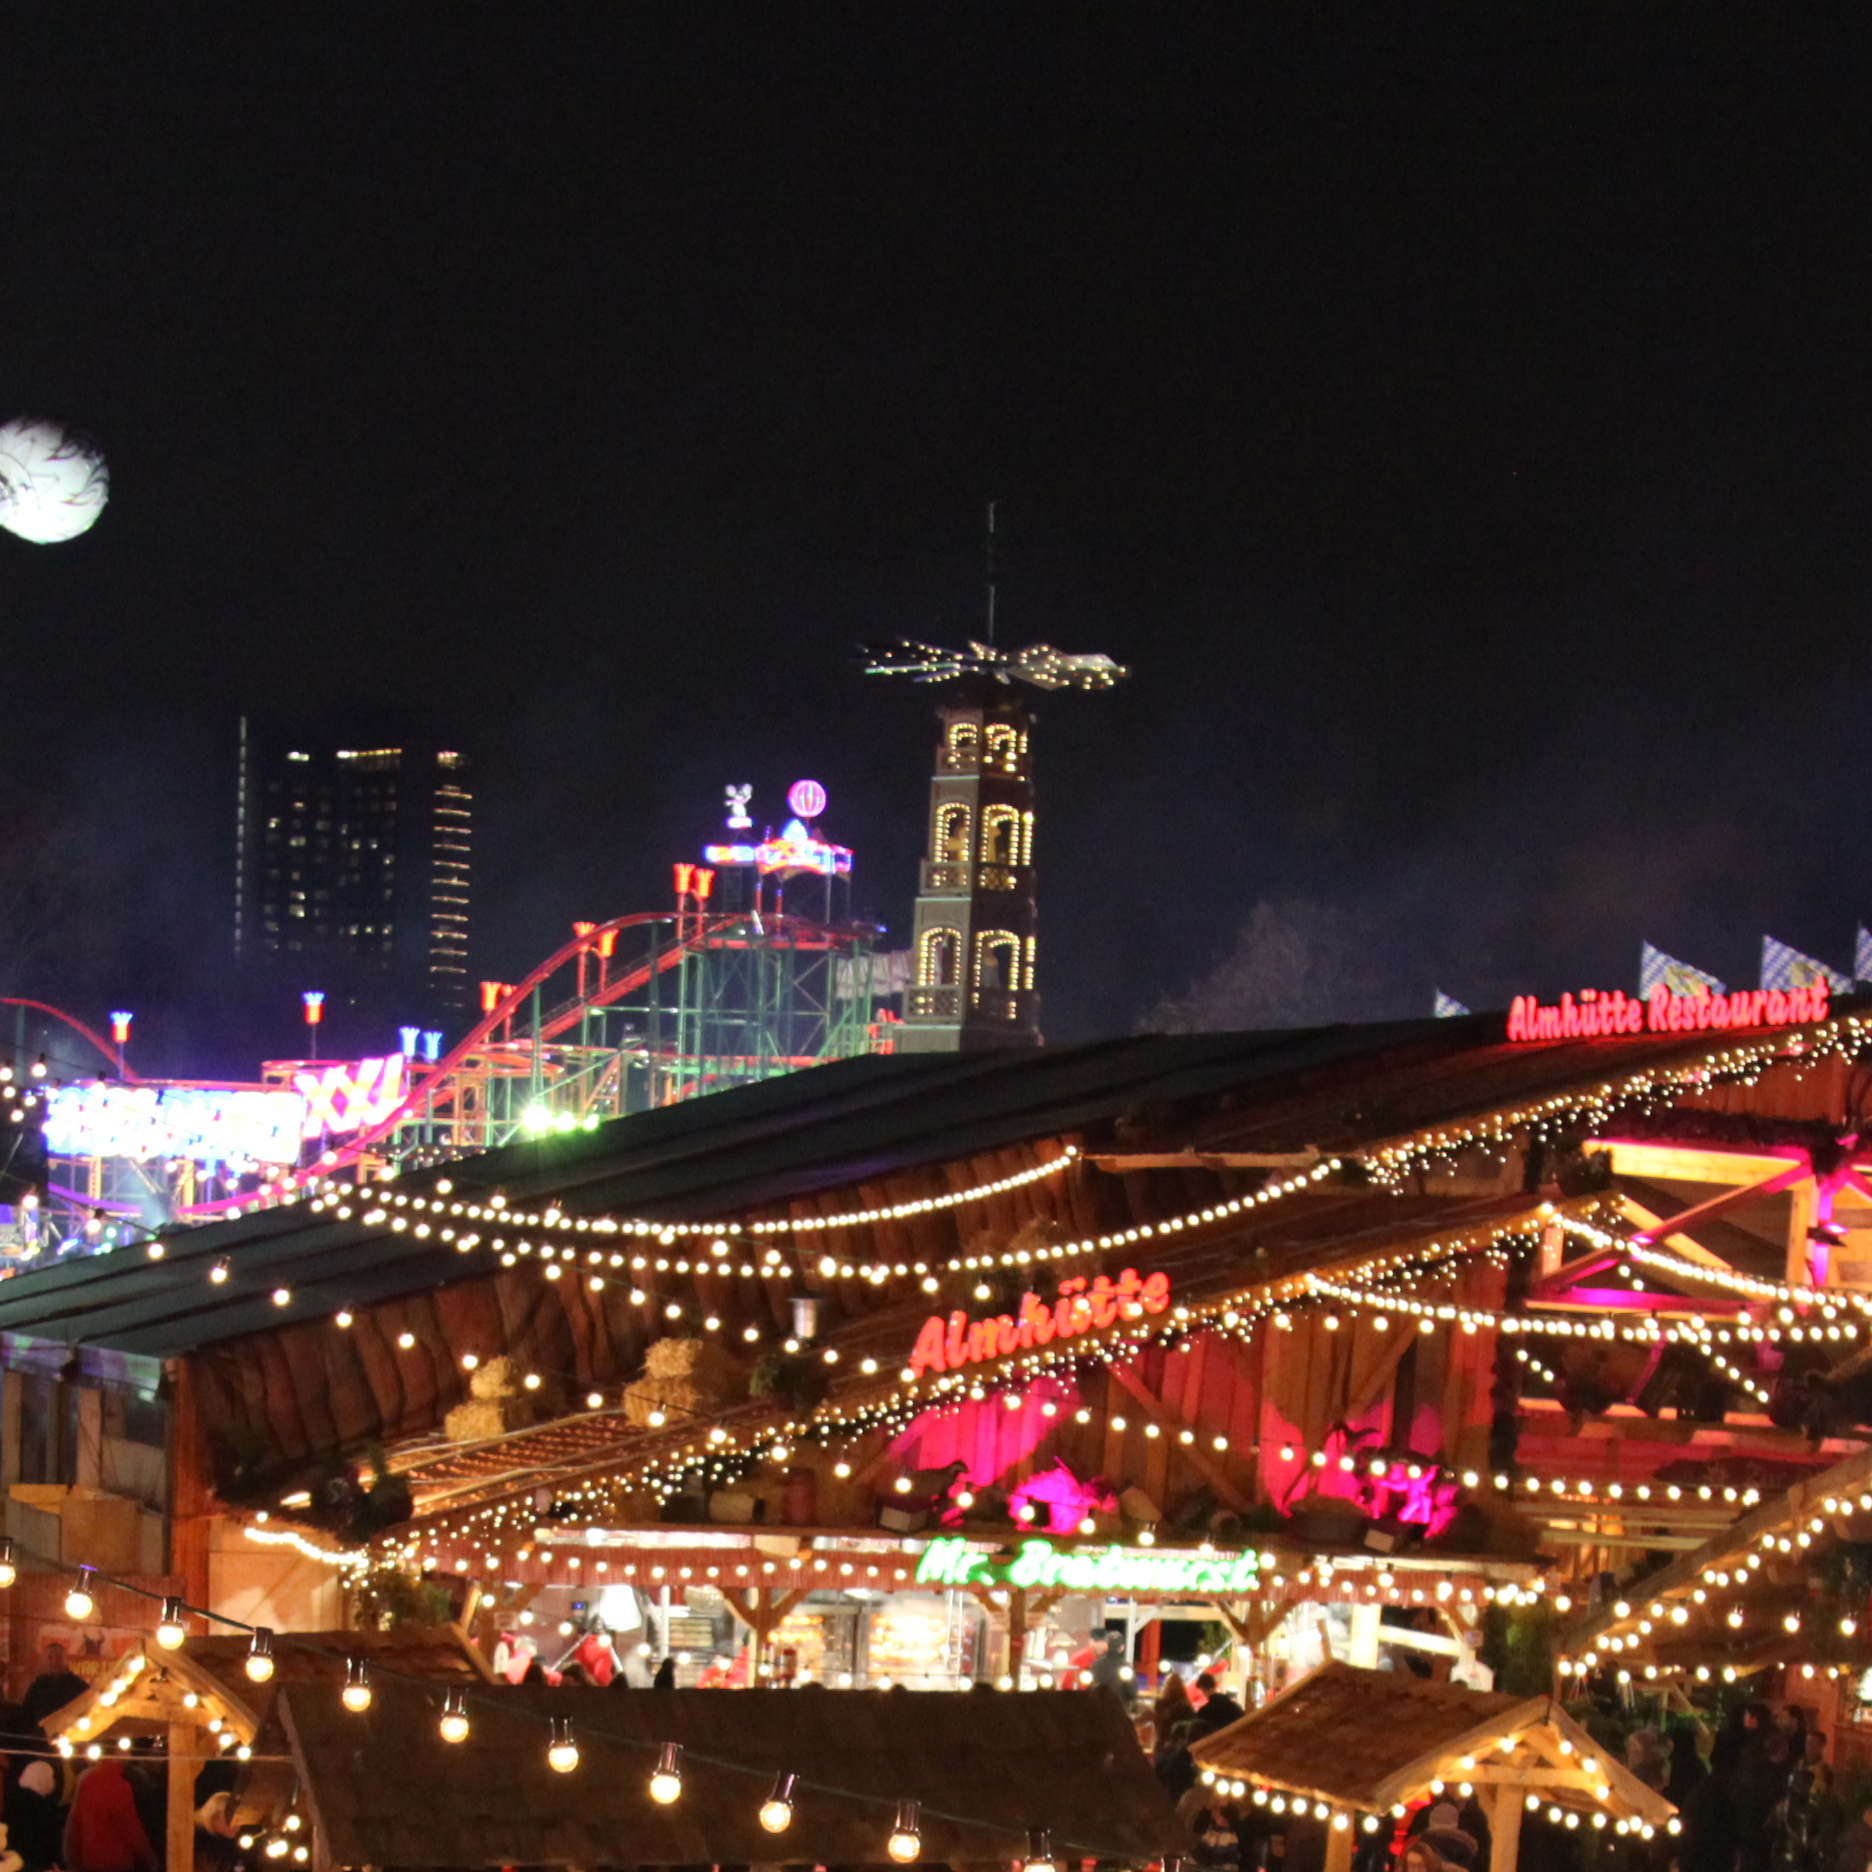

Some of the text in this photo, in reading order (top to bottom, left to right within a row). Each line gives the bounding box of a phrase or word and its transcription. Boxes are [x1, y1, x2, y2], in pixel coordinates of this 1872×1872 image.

[1506, 975, 1829, 1041] Almhütte Restaurant
[294, 1053, 408, 1139] XXL
[906, 1267, 1171, 1378] Almhütte
[915, 1537, 1264, 1593] Mr. Bratwurst
